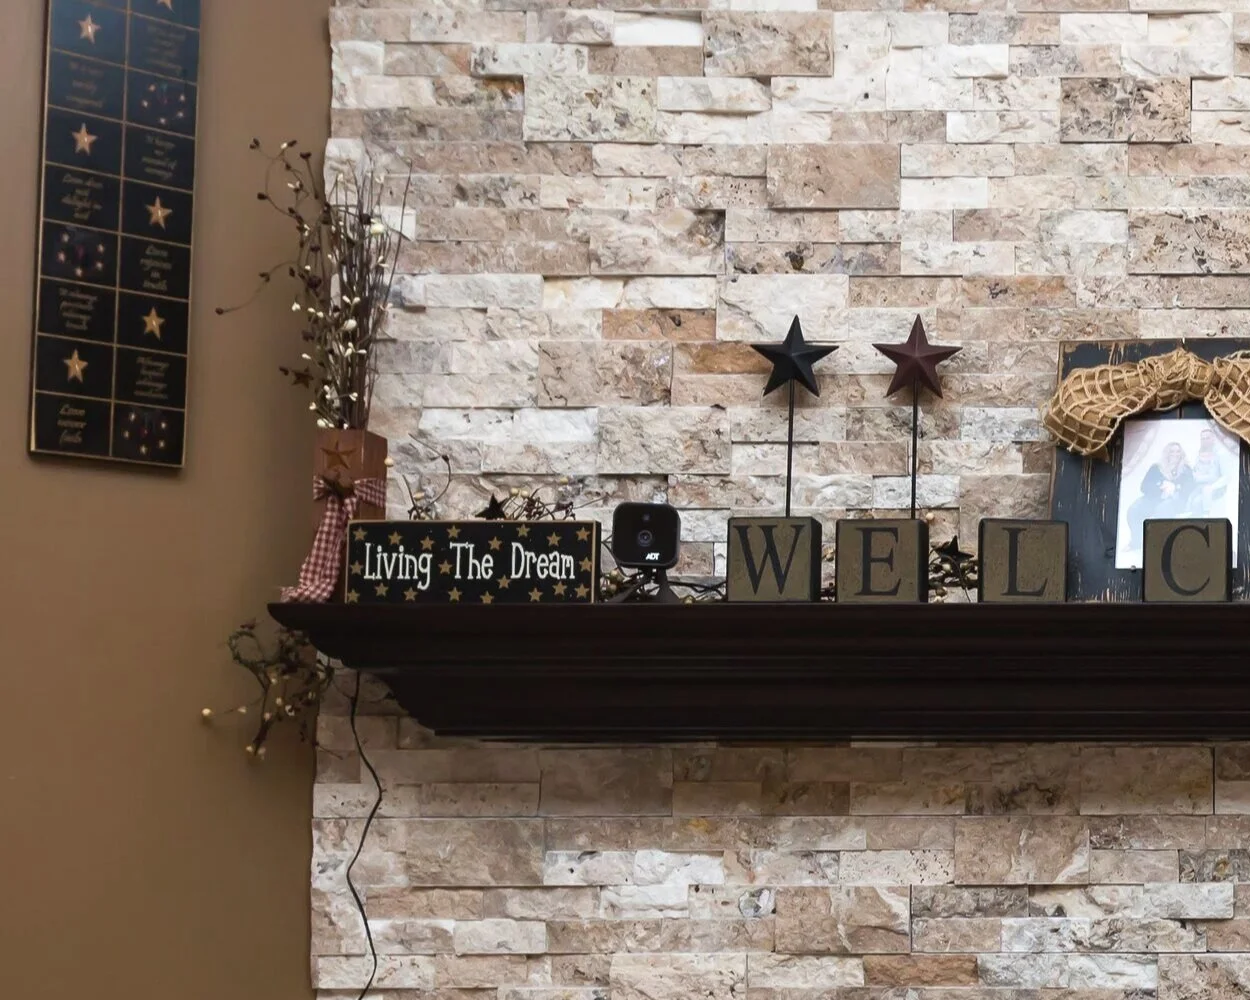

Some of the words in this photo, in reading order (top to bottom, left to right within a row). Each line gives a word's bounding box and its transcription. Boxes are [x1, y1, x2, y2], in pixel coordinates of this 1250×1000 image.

[363, 541, 432, 590] Living
[449, 541, 494, 580] The
[511, 541, 575, 580] Dream
[646, 552, 659, 560] ADT
